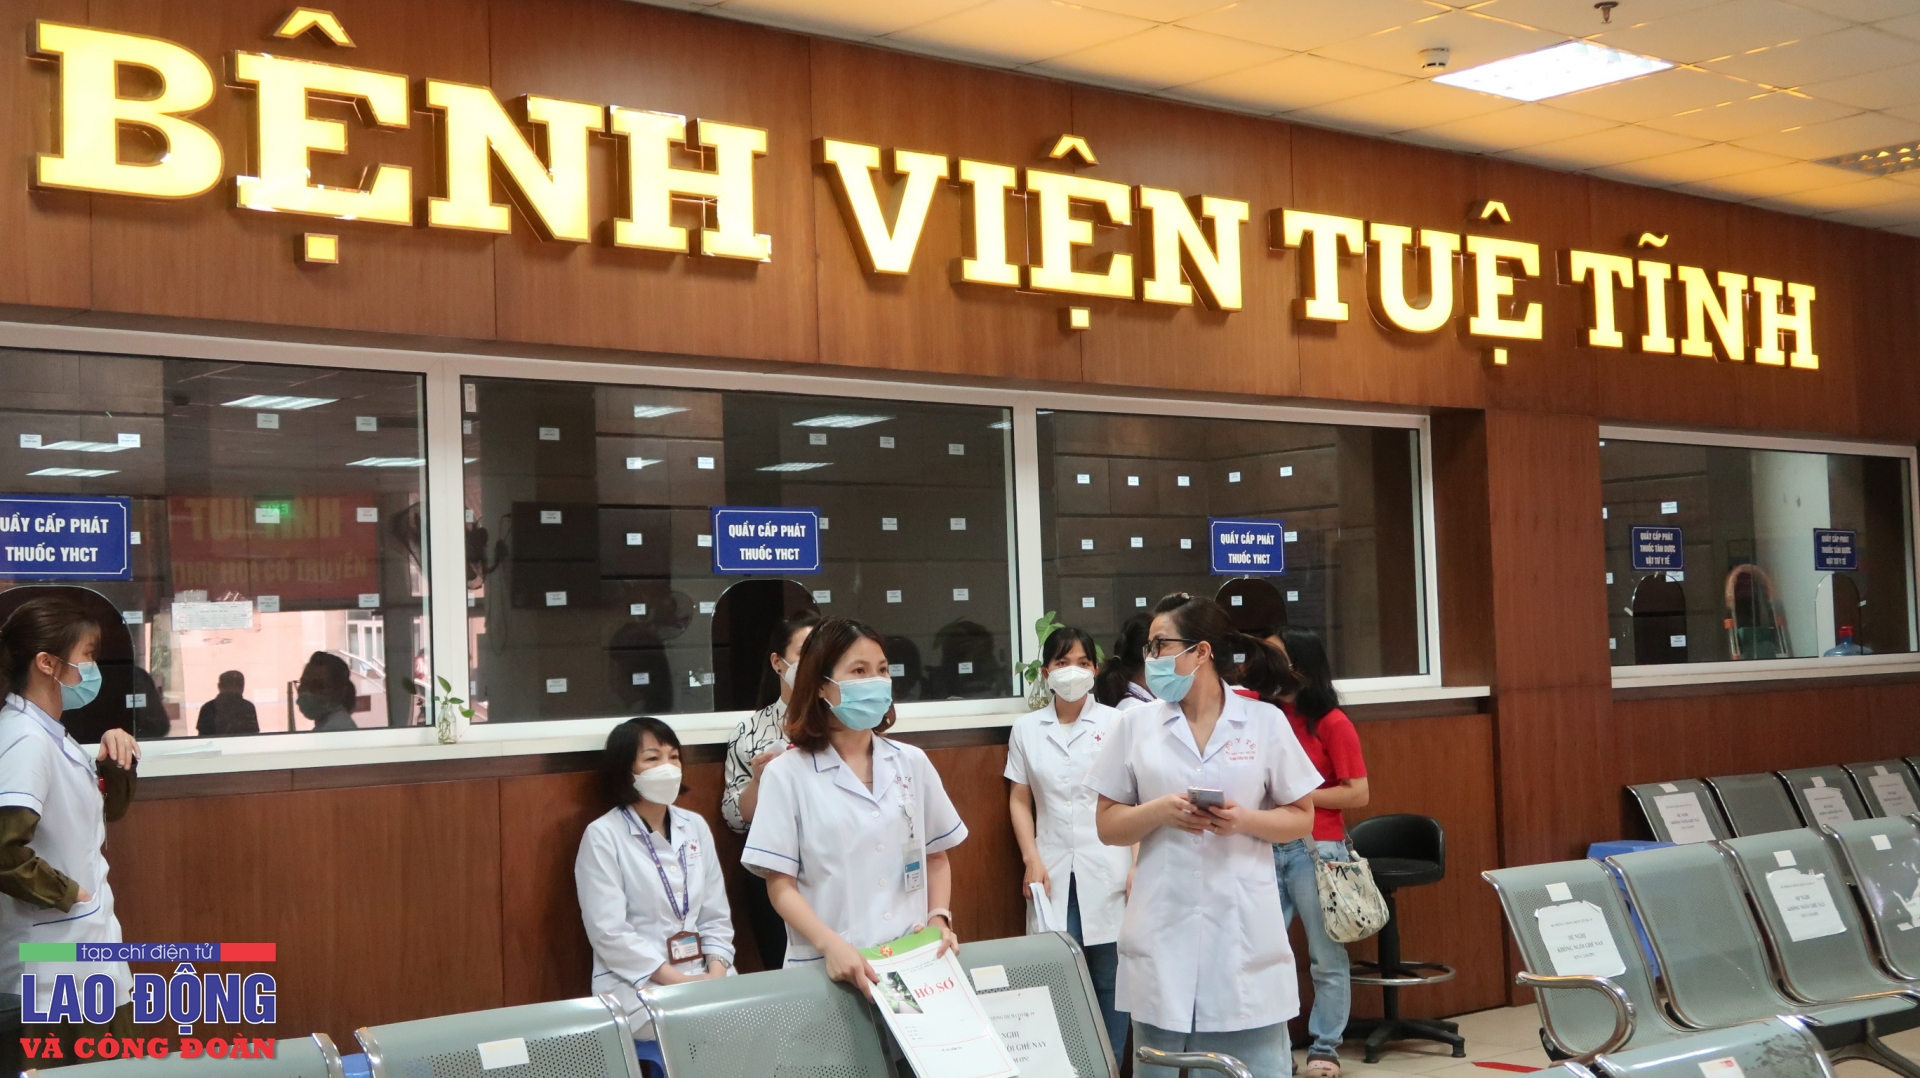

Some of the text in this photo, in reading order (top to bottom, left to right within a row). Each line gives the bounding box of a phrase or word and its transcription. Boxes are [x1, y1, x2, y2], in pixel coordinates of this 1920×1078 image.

[36, 7, 1820, 370] BỆNH VIỆN TUỆ TĨNH
[0, 512, 109, 533] UẦY CẤP PHÁT
[757, 521, 778, 537] CẤP
[780, 523, 806, 537] PHÁT
[1240, 531, 1255, 545] CẤP
[1256, 533, 1275, 545] PHÁT
[5, 542, 98, 562] THUỐC YHCT
[739, 544, 800, 560] THUỐC YHCT
[1228, 550, 1270, 564] THUỐC YHCT
[914, 976, 955, 999] HỒ SƠ
